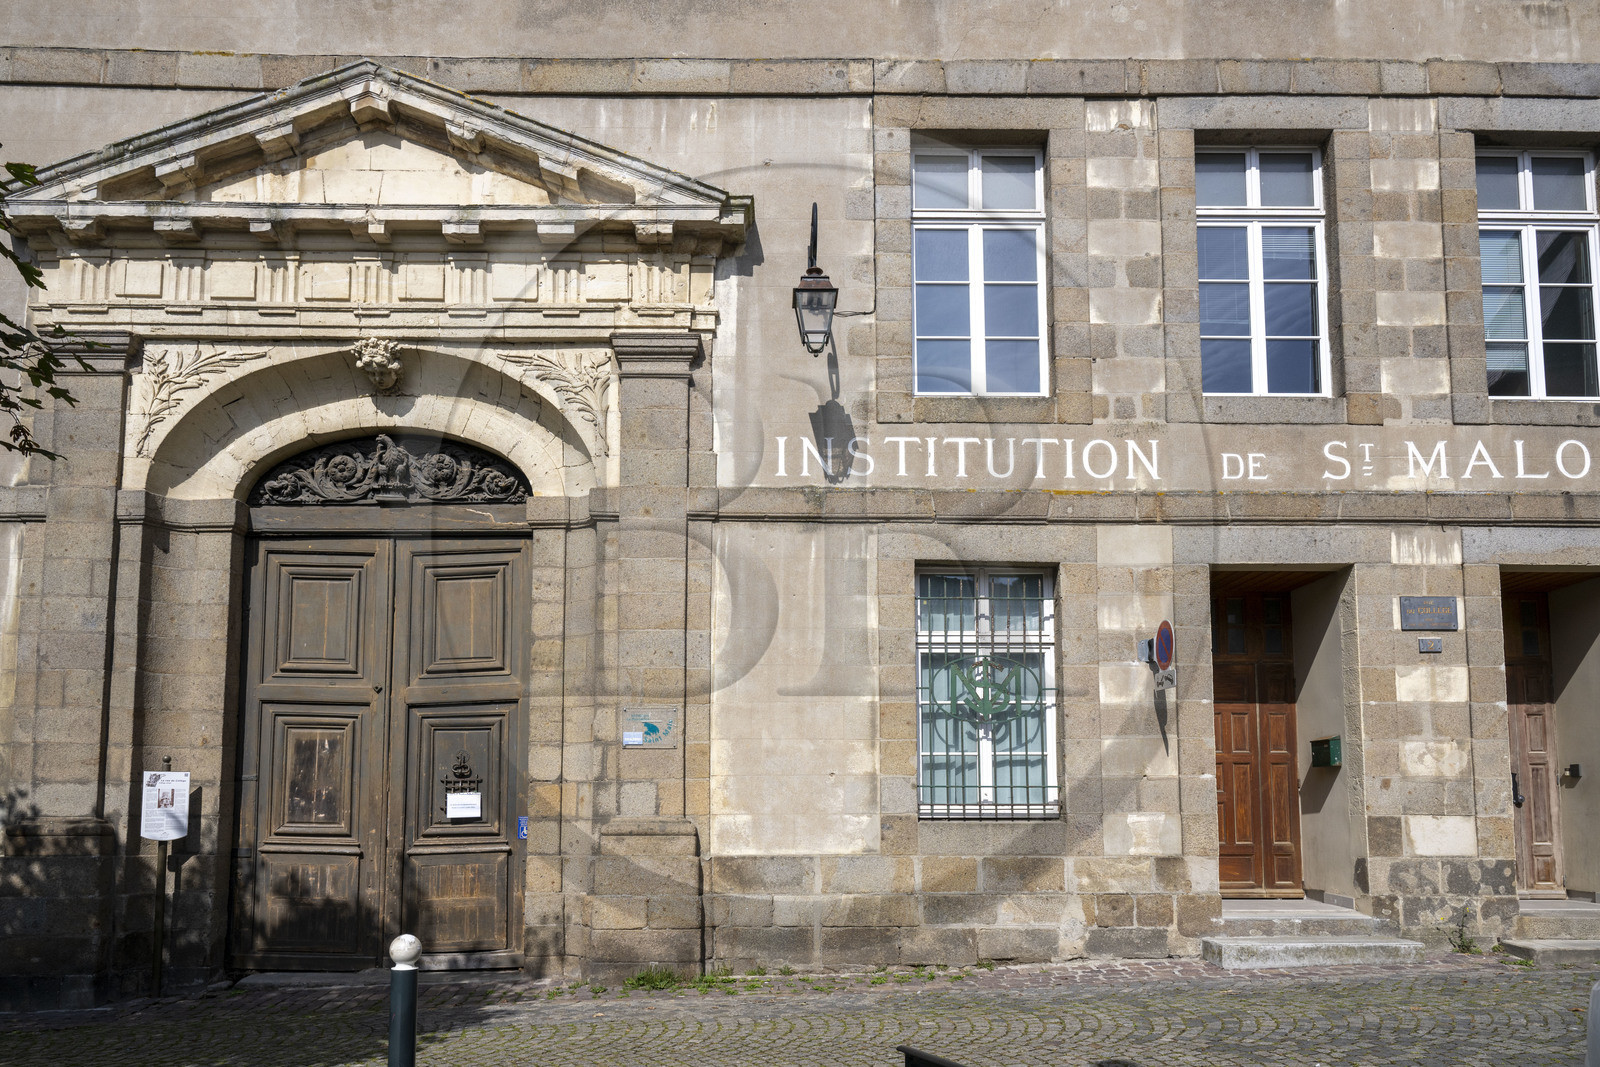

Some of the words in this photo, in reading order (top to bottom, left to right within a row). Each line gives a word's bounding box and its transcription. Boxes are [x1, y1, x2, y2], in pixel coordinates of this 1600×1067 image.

[774, 435, 1162, 481] INSTITUTION
[1220, 453, 1268, 480] DE
[1403, 439, 1592, 480] MALO
[1427, 640, 1435, 650] 2
